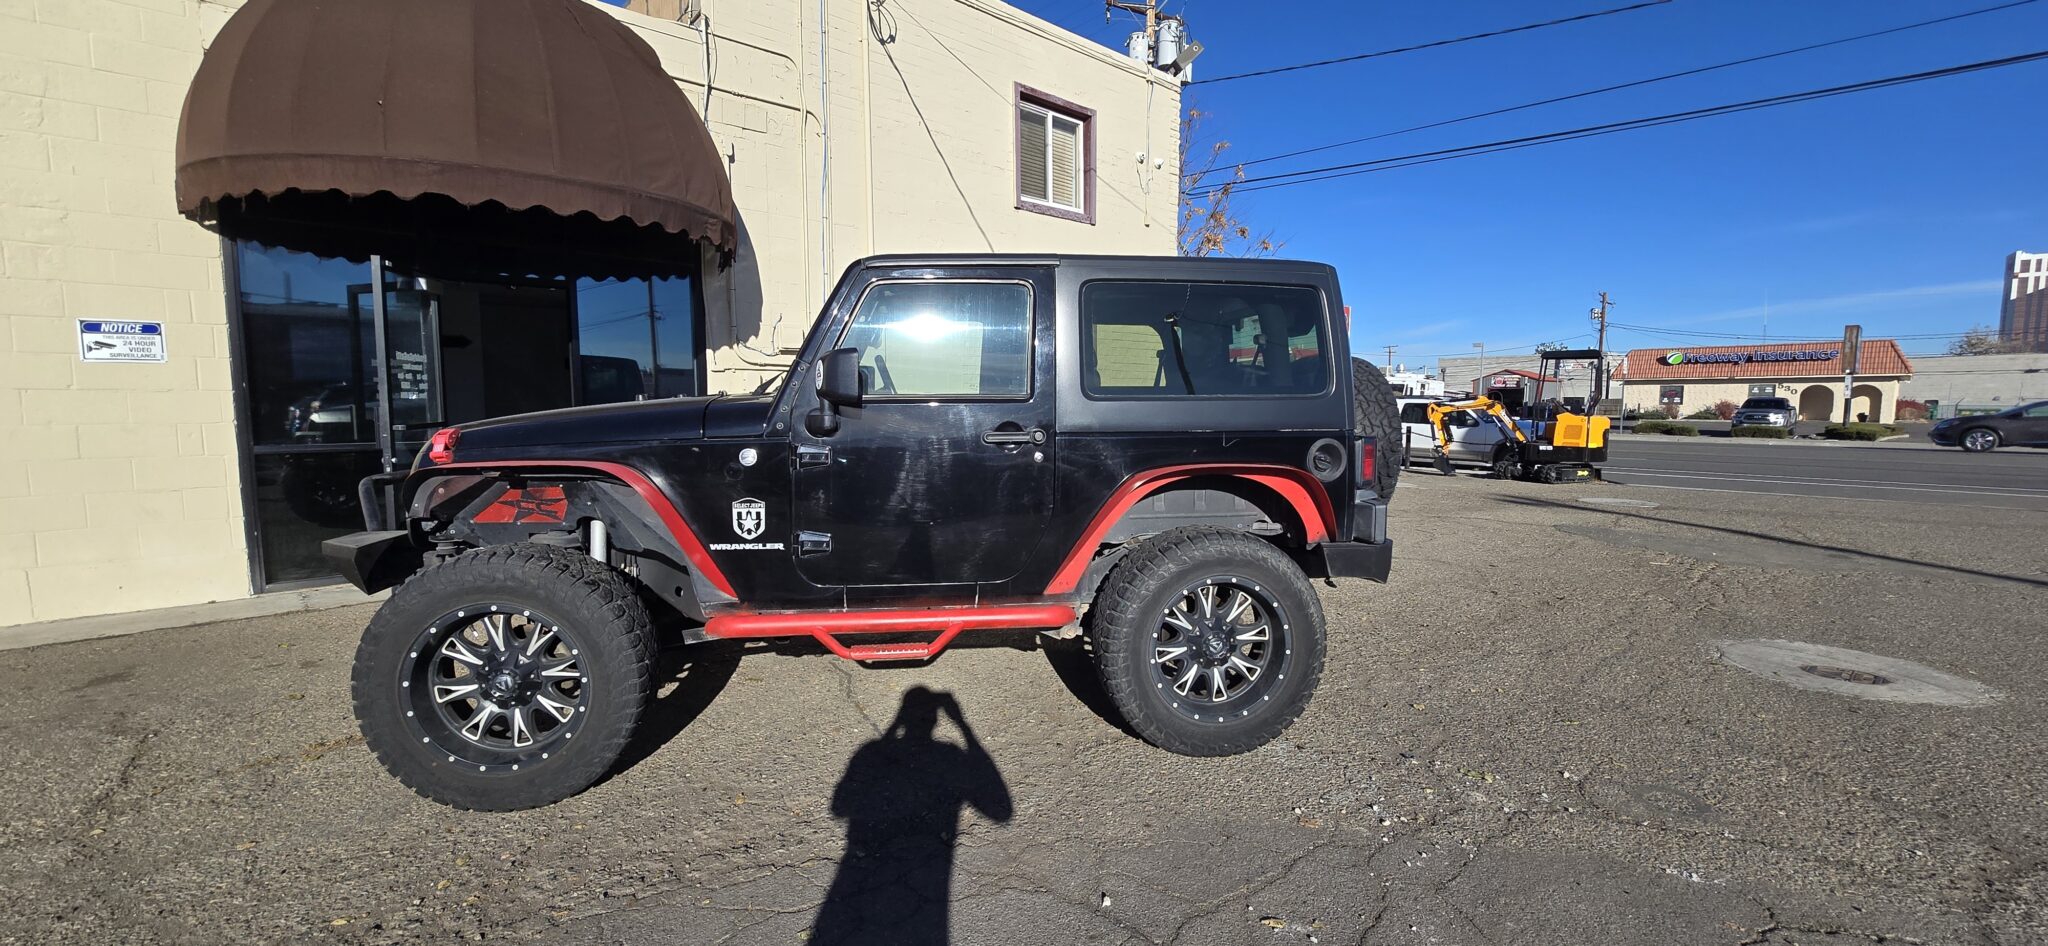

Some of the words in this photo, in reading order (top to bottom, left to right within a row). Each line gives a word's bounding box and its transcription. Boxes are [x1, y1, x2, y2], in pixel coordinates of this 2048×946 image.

[100, 323, 143, 333] NOTICE
[1683, 352, 1749, 364] Freeway
[1752, 349, 1840, 361] Insurance
[1777, 382, 1798, 395] 530
